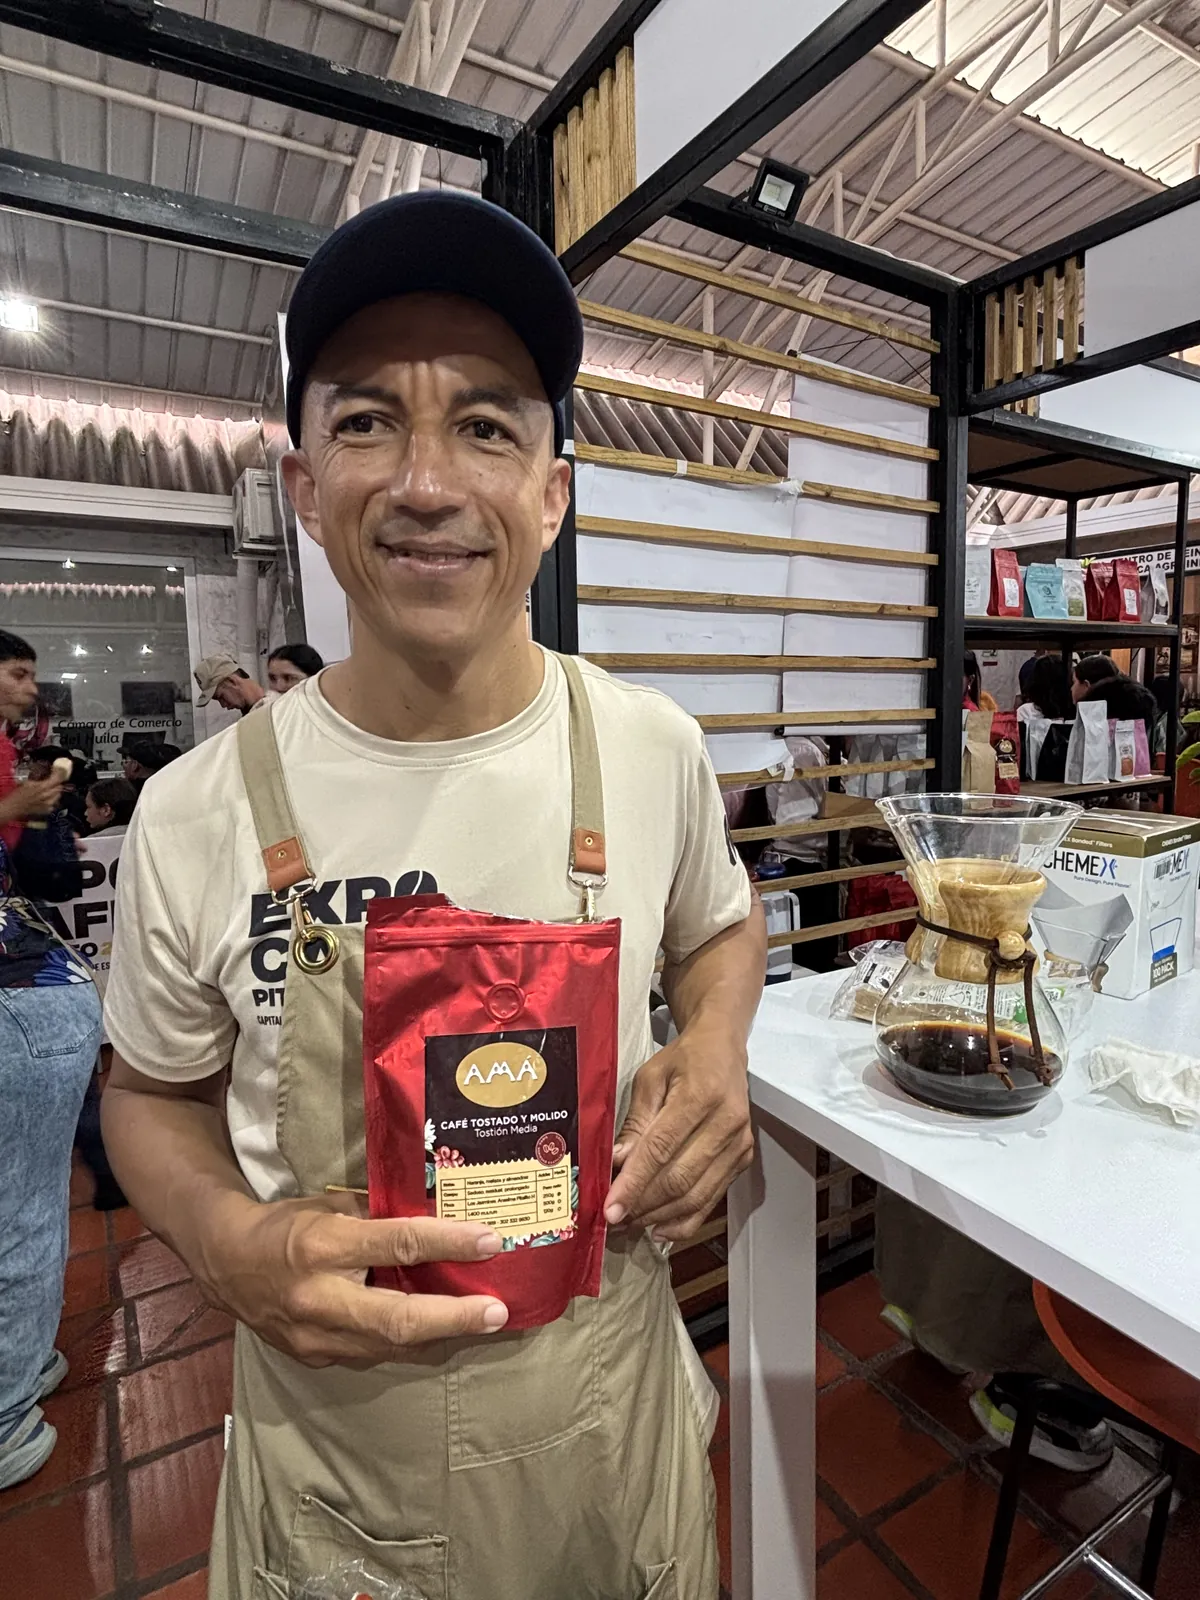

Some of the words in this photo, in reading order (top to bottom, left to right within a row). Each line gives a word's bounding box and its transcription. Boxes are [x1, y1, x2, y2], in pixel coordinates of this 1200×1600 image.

[1157, 551, 1171, 561] DE
[1186, 558, 1200, 569] IN
[57, 718, 106, 729] Cámara
[110, 718, 125, 729] de
[129, 717, 182, 729] Comercio
[440, 1117, 468, 1131] CAFÉ
[470, 1115, 518, 1128] TOSTADO
[520, 1114, 529, 1125] Y
[530, 1110, 568, 1122] MOLIDO
[474, 1125, 509, 1139] Tostión
[510, 1123, 538, 1135] Media
